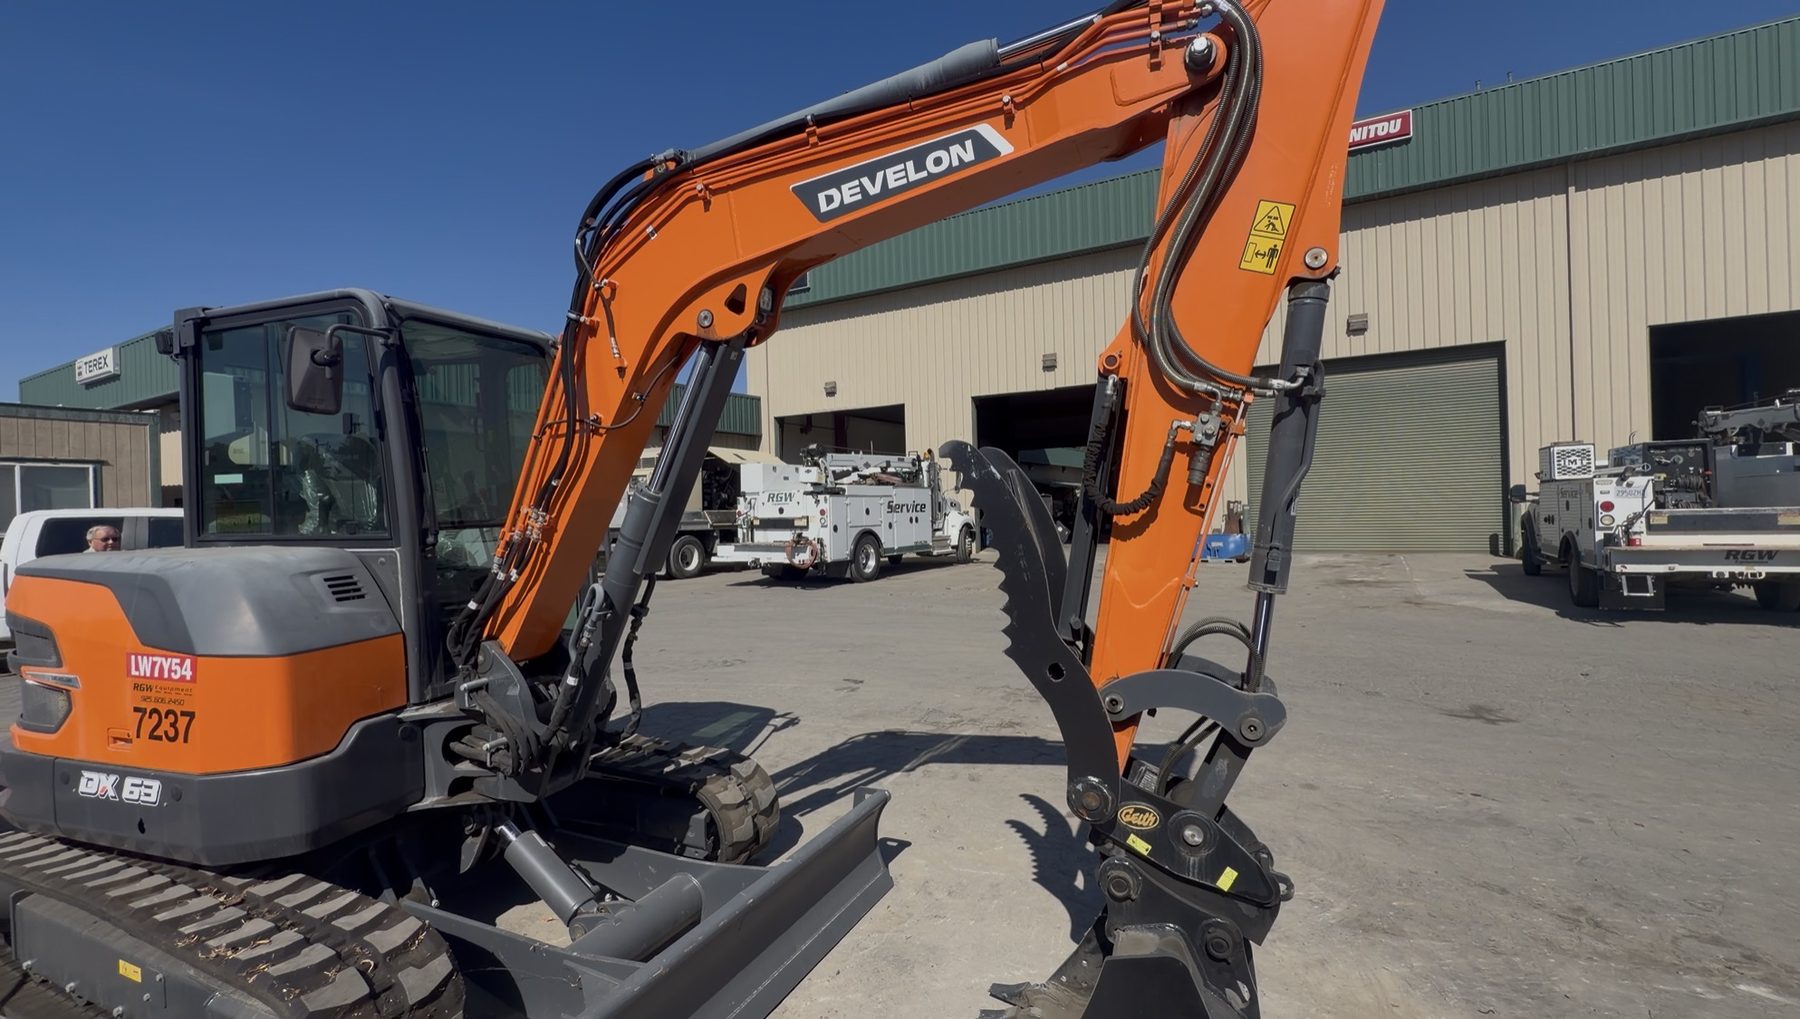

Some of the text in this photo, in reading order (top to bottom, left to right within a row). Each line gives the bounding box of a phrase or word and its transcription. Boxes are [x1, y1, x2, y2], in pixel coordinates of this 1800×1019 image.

[1349, 118, 1402, 143] NITOU
[817, 138, 976, 213] DEVELON
[84, 354, 109, 375] TEREX
[1562, 458, 1585, 466] IMT
[767, 492, 796, 503] RGW
[886, 500, 926, 514] Service
[1724, 549, 1780, 561] RGW
[130, 654, 193, 681] LW7Y54
[133, 682, 193, 693] RGW Equipment
[133, 706, 196, 744] 7237
[78, 770, 162, 807] DX 63
